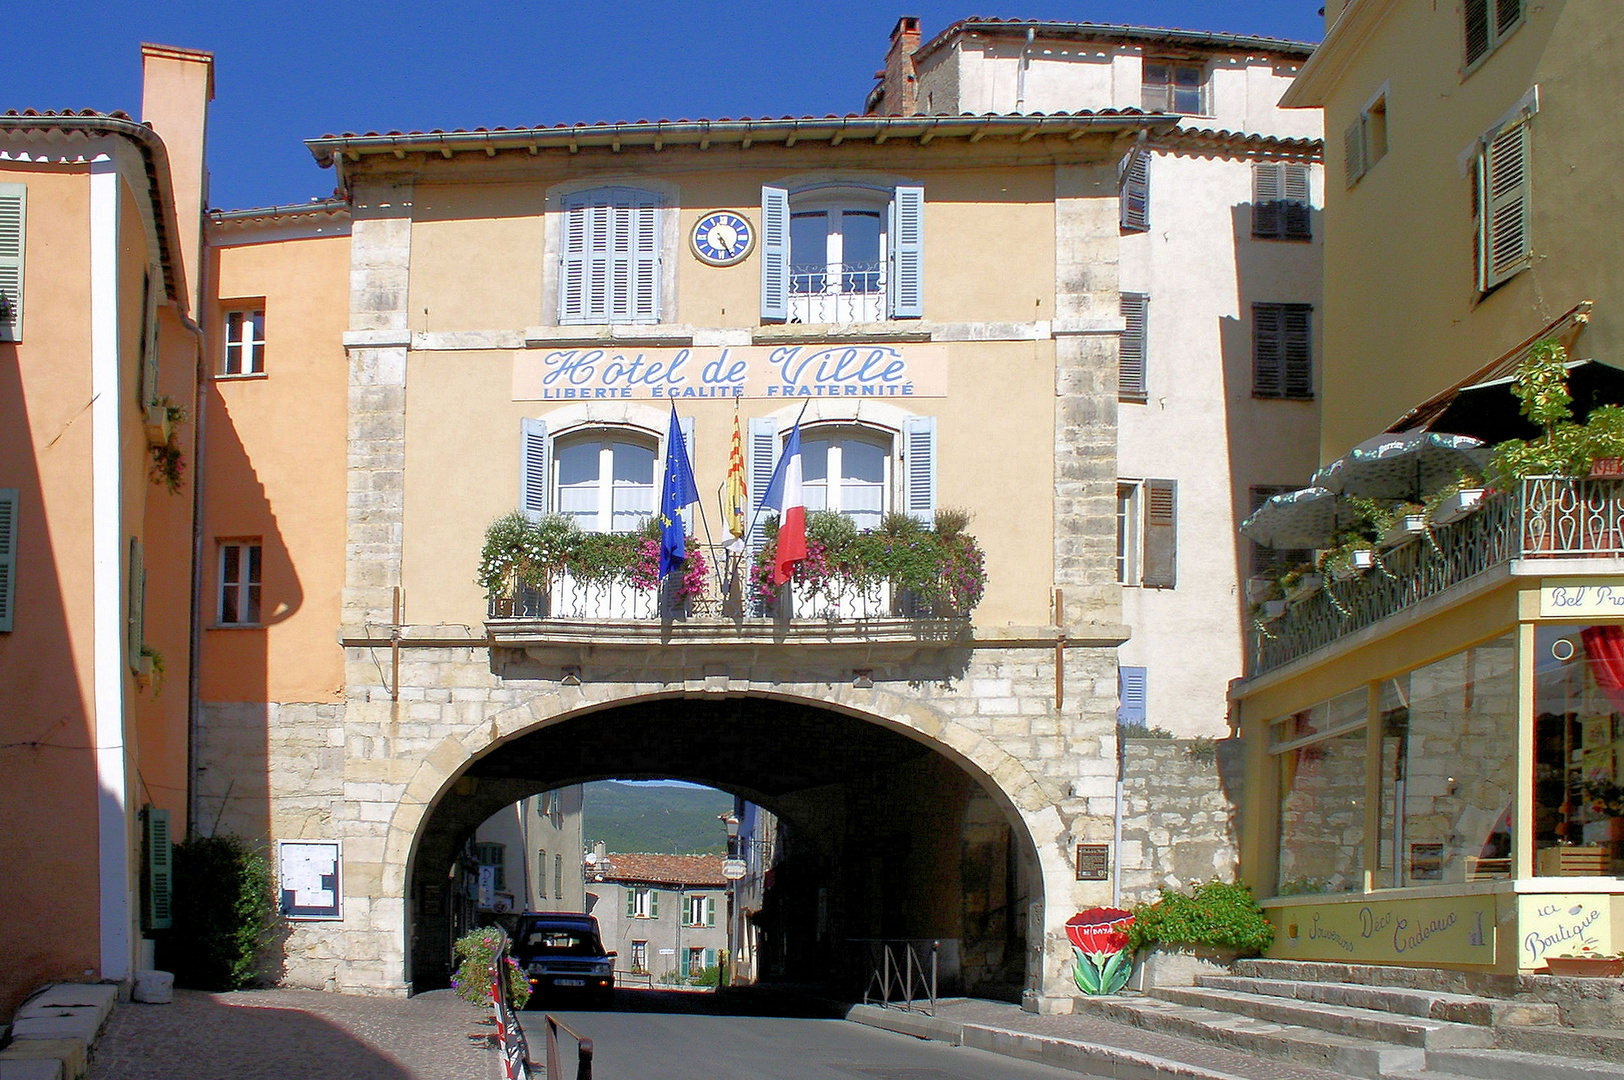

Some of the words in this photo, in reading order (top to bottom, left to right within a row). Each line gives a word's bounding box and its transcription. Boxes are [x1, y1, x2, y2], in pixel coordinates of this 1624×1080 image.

[542, 349, 690, 386] Hôtel
[701, 349, 747, 385] de
[769, 346, 905, 385] Ville
[543, 384, 633, 399] LIBERTÉ
[651, 383, 745, 398] ÉGALITÉ
[767, 381, 914, 397] FRATERNITÉ
[1537, 904, 1562, 918] ici
[1393, 911, 1457, 953] Cadeaux
[1524, 909, 1601, 962] Boutique
